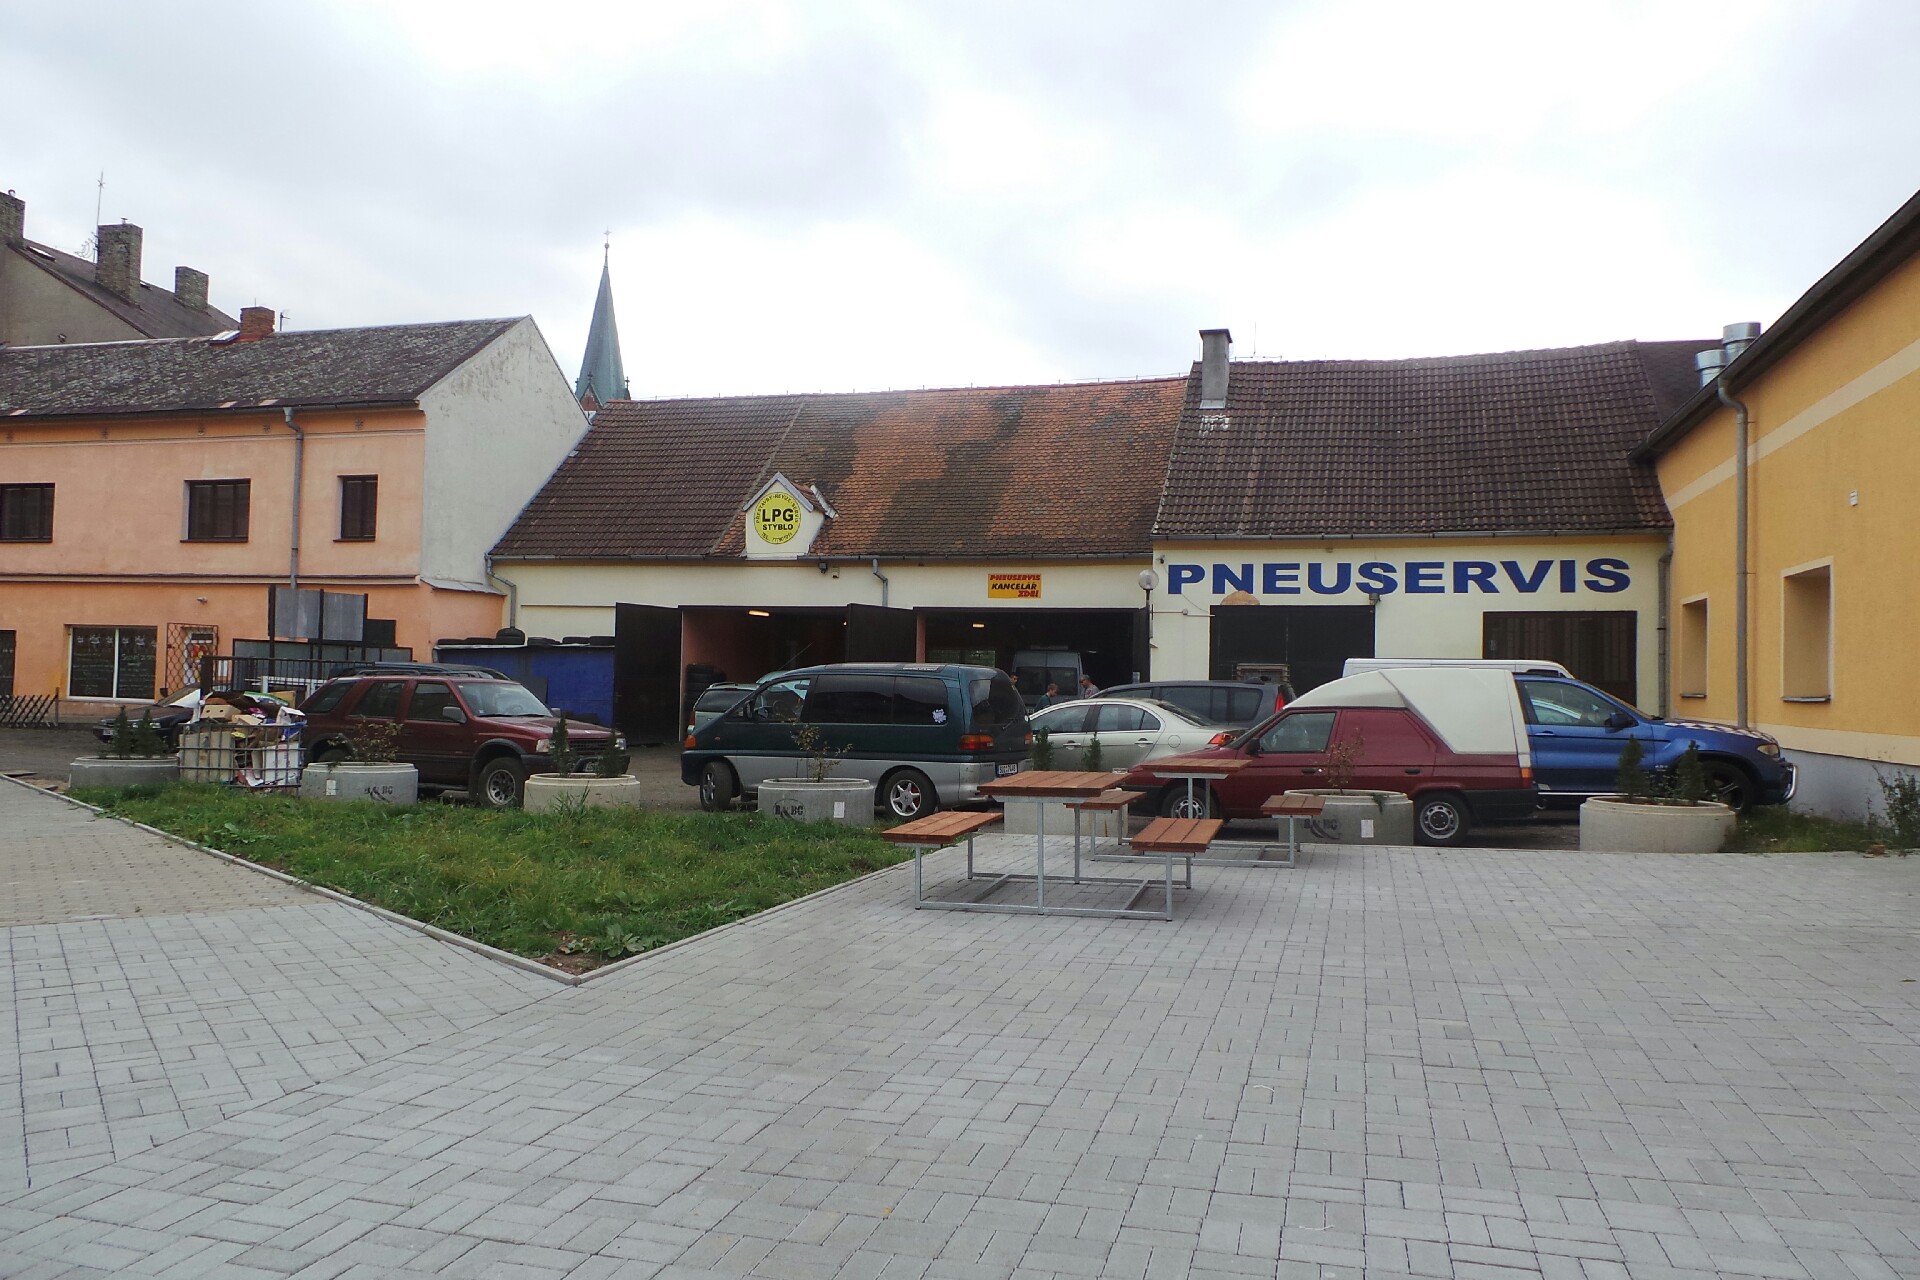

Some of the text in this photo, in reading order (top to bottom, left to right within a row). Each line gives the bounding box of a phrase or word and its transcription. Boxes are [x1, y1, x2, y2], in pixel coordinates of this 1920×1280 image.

[762, 509, 794, 522] LPG
[1167, 558, 1632, 595] PNEUSERVIS
[992, 582, 1037, 590] KANCELÁŘ
